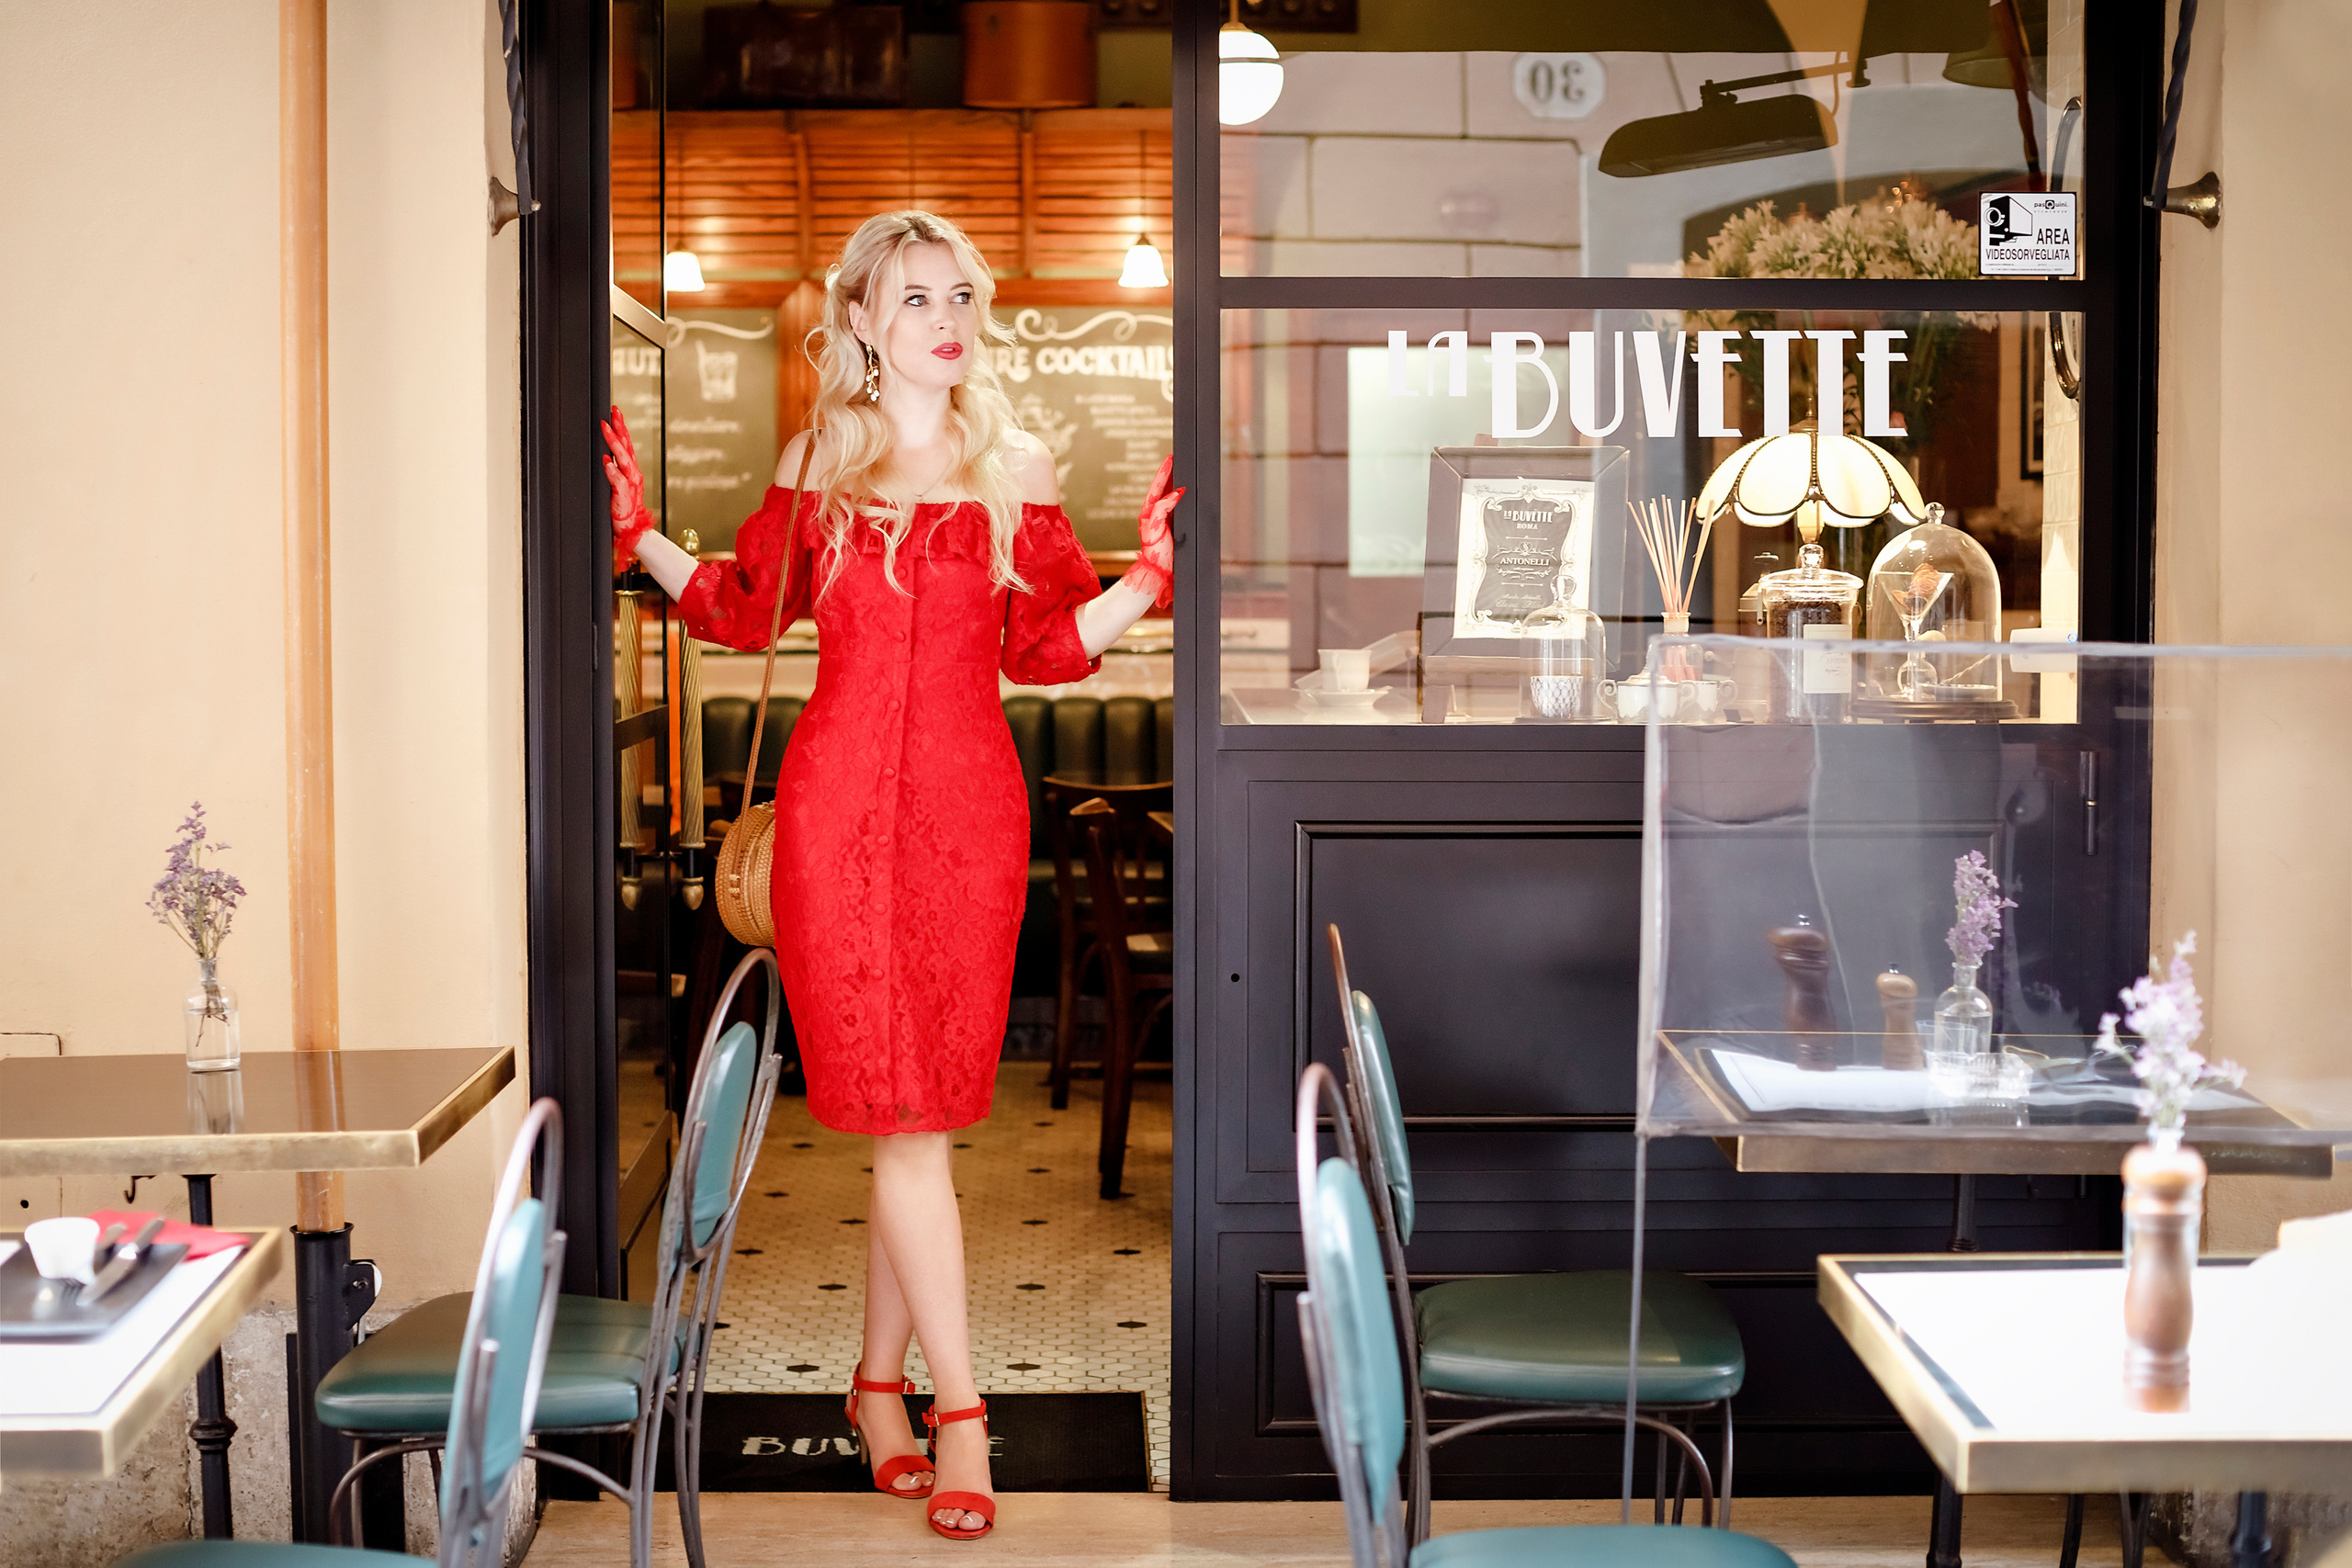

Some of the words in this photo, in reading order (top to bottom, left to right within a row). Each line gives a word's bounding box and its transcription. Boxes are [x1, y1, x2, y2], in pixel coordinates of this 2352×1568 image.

[2036, 228, 2070, 244] AREA
[1985, 249, 2070, 260] VIDEOSORVEGLIATA
[1387, 330, 1468, 397] LA
[1483, 330, 1908, 438] BUVETTE
[1500, 557, 1550, 566] ANTONELLI
